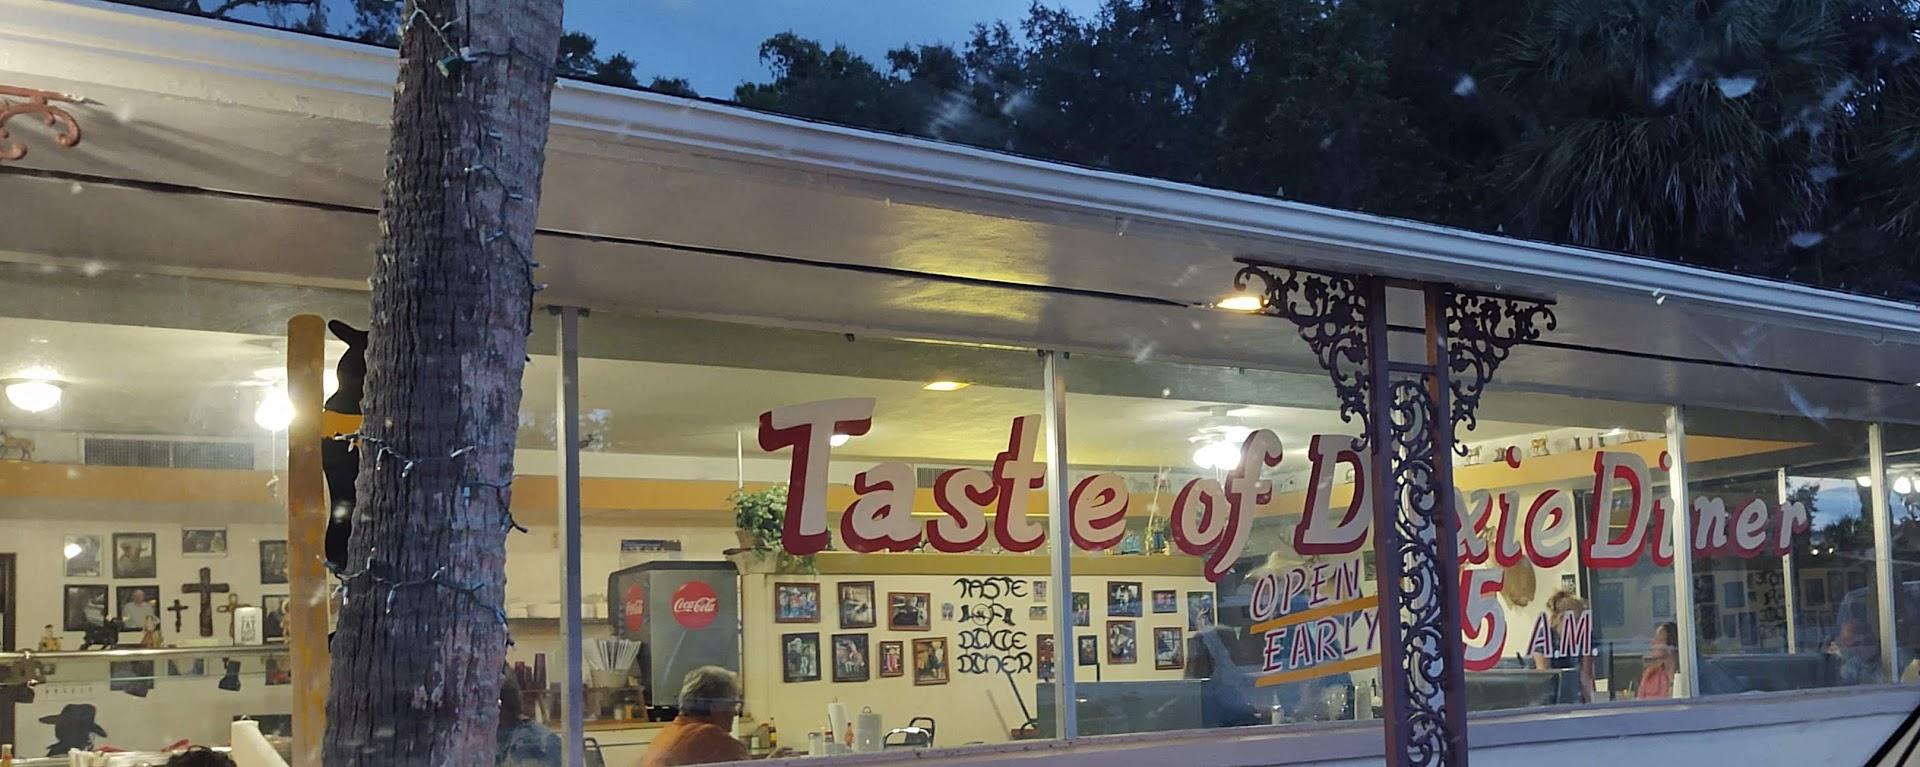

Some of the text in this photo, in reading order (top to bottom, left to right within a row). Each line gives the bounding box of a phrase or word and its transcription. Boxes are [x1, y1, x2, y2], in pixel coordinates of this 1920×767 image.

[758, 398, 1808, 582] Taste of Dxie Diner
[953, 577, 1028, 599] TASTE
[1251, 558, 1360, 621] OPEN
[1263, 608, 1380, 672] EARLY
[1459, 569, 1598, 671] 5 A.M.
[957, 652, 1033, 674] DINER
